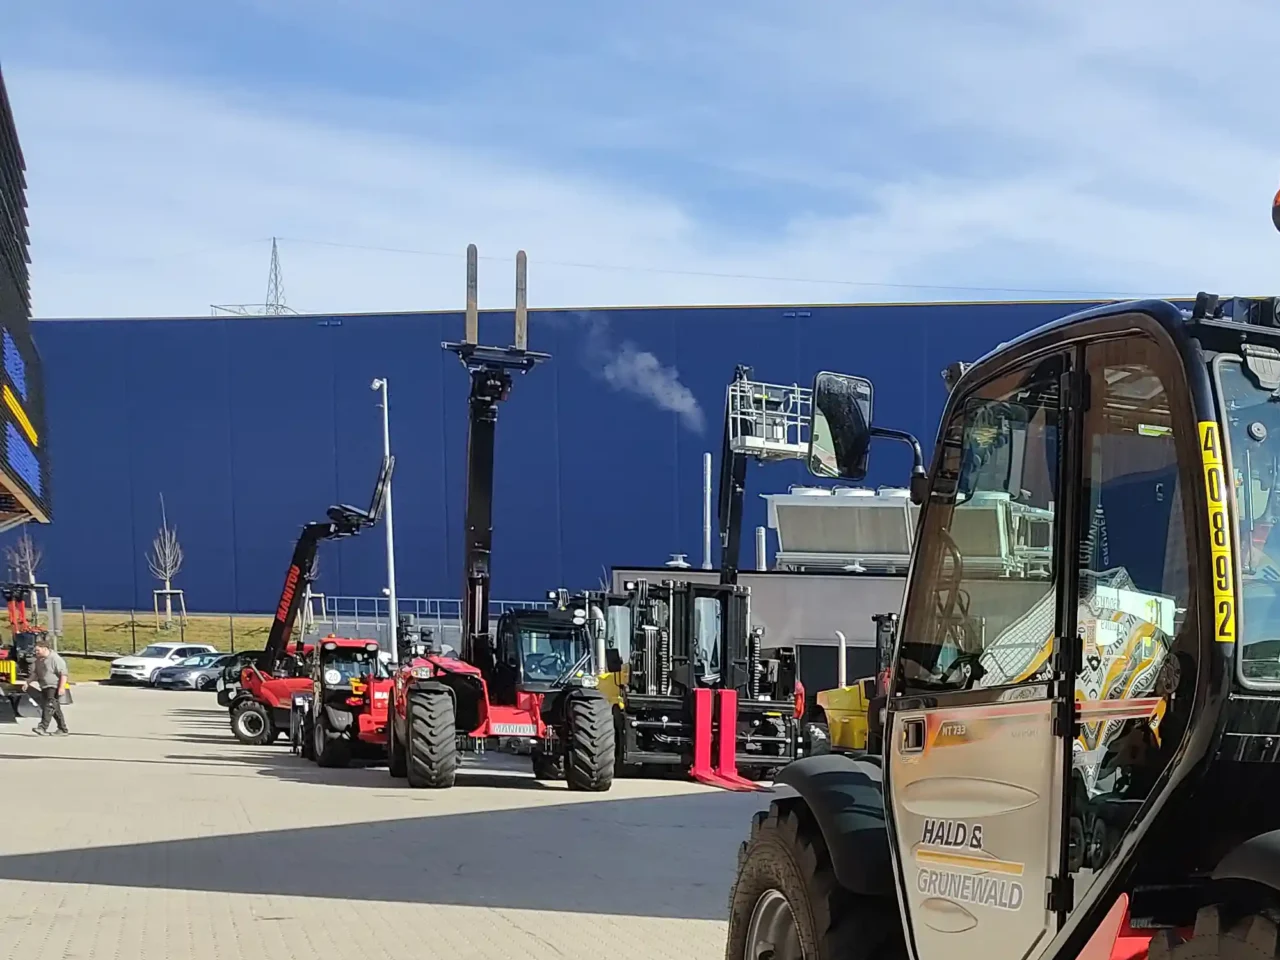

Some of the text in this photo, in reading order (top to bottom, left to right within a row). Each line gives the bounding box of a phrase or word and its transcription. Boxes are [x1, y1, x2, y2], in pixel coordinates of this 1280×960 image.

[1203, 426, 1232, 637] 40892
[277, 564, 300, 623] MANITOU
[922, 819, 984, 849] HALD &
[917, 869, 1024, 912] GRUNEWALD
